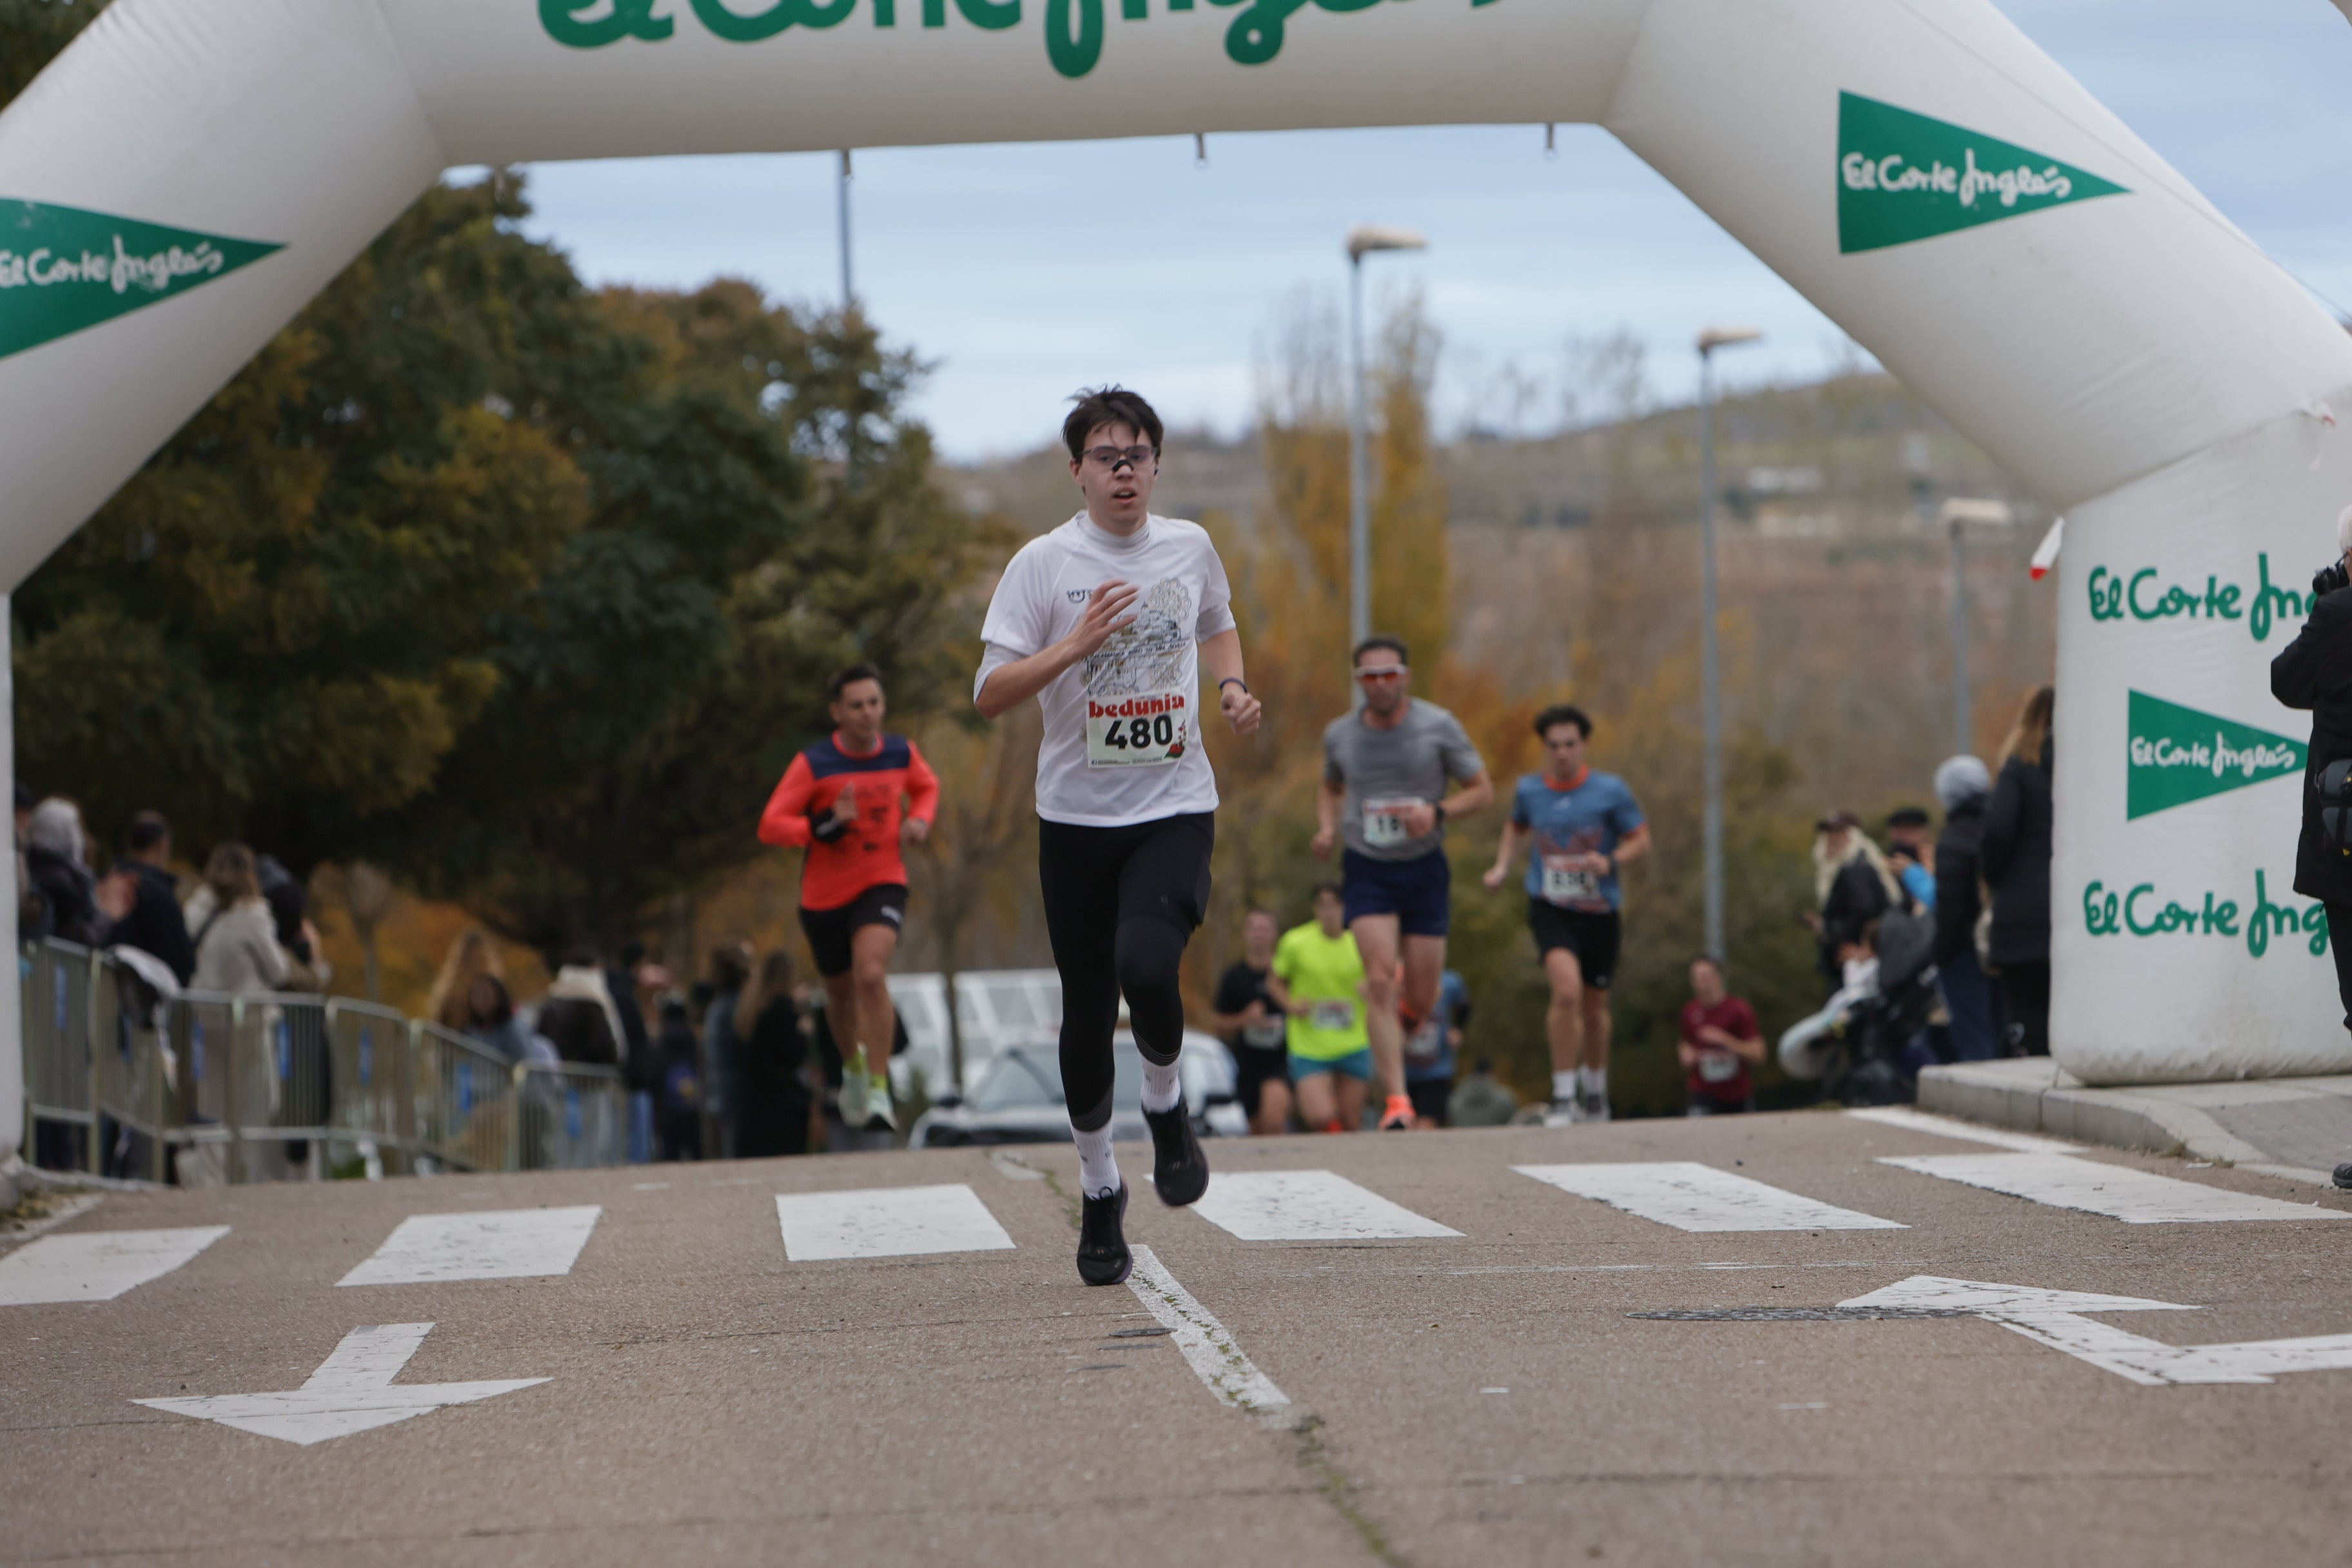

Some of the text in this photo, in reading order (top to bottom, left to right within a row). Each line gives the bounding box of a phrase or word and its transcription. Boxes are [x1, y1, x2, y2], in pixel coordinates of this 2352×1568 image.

[1841, 148, 2072, 206] El Corte Inglés
[28, 248, 110, 286] Corte
[111, 233, 224, 294] Inglés
[2088, 565, 2124, 621] El
[2128, 567, 2242, 621] Corte
[1088, 692, 1184, 718] bedunia
[1105, 714, 1173, 750] 480
[2130, 731, 2296, 777] El Corte Inglés
[2083, 880, 2121, 937] El
[2125, 883, 2239, 937] Corte
